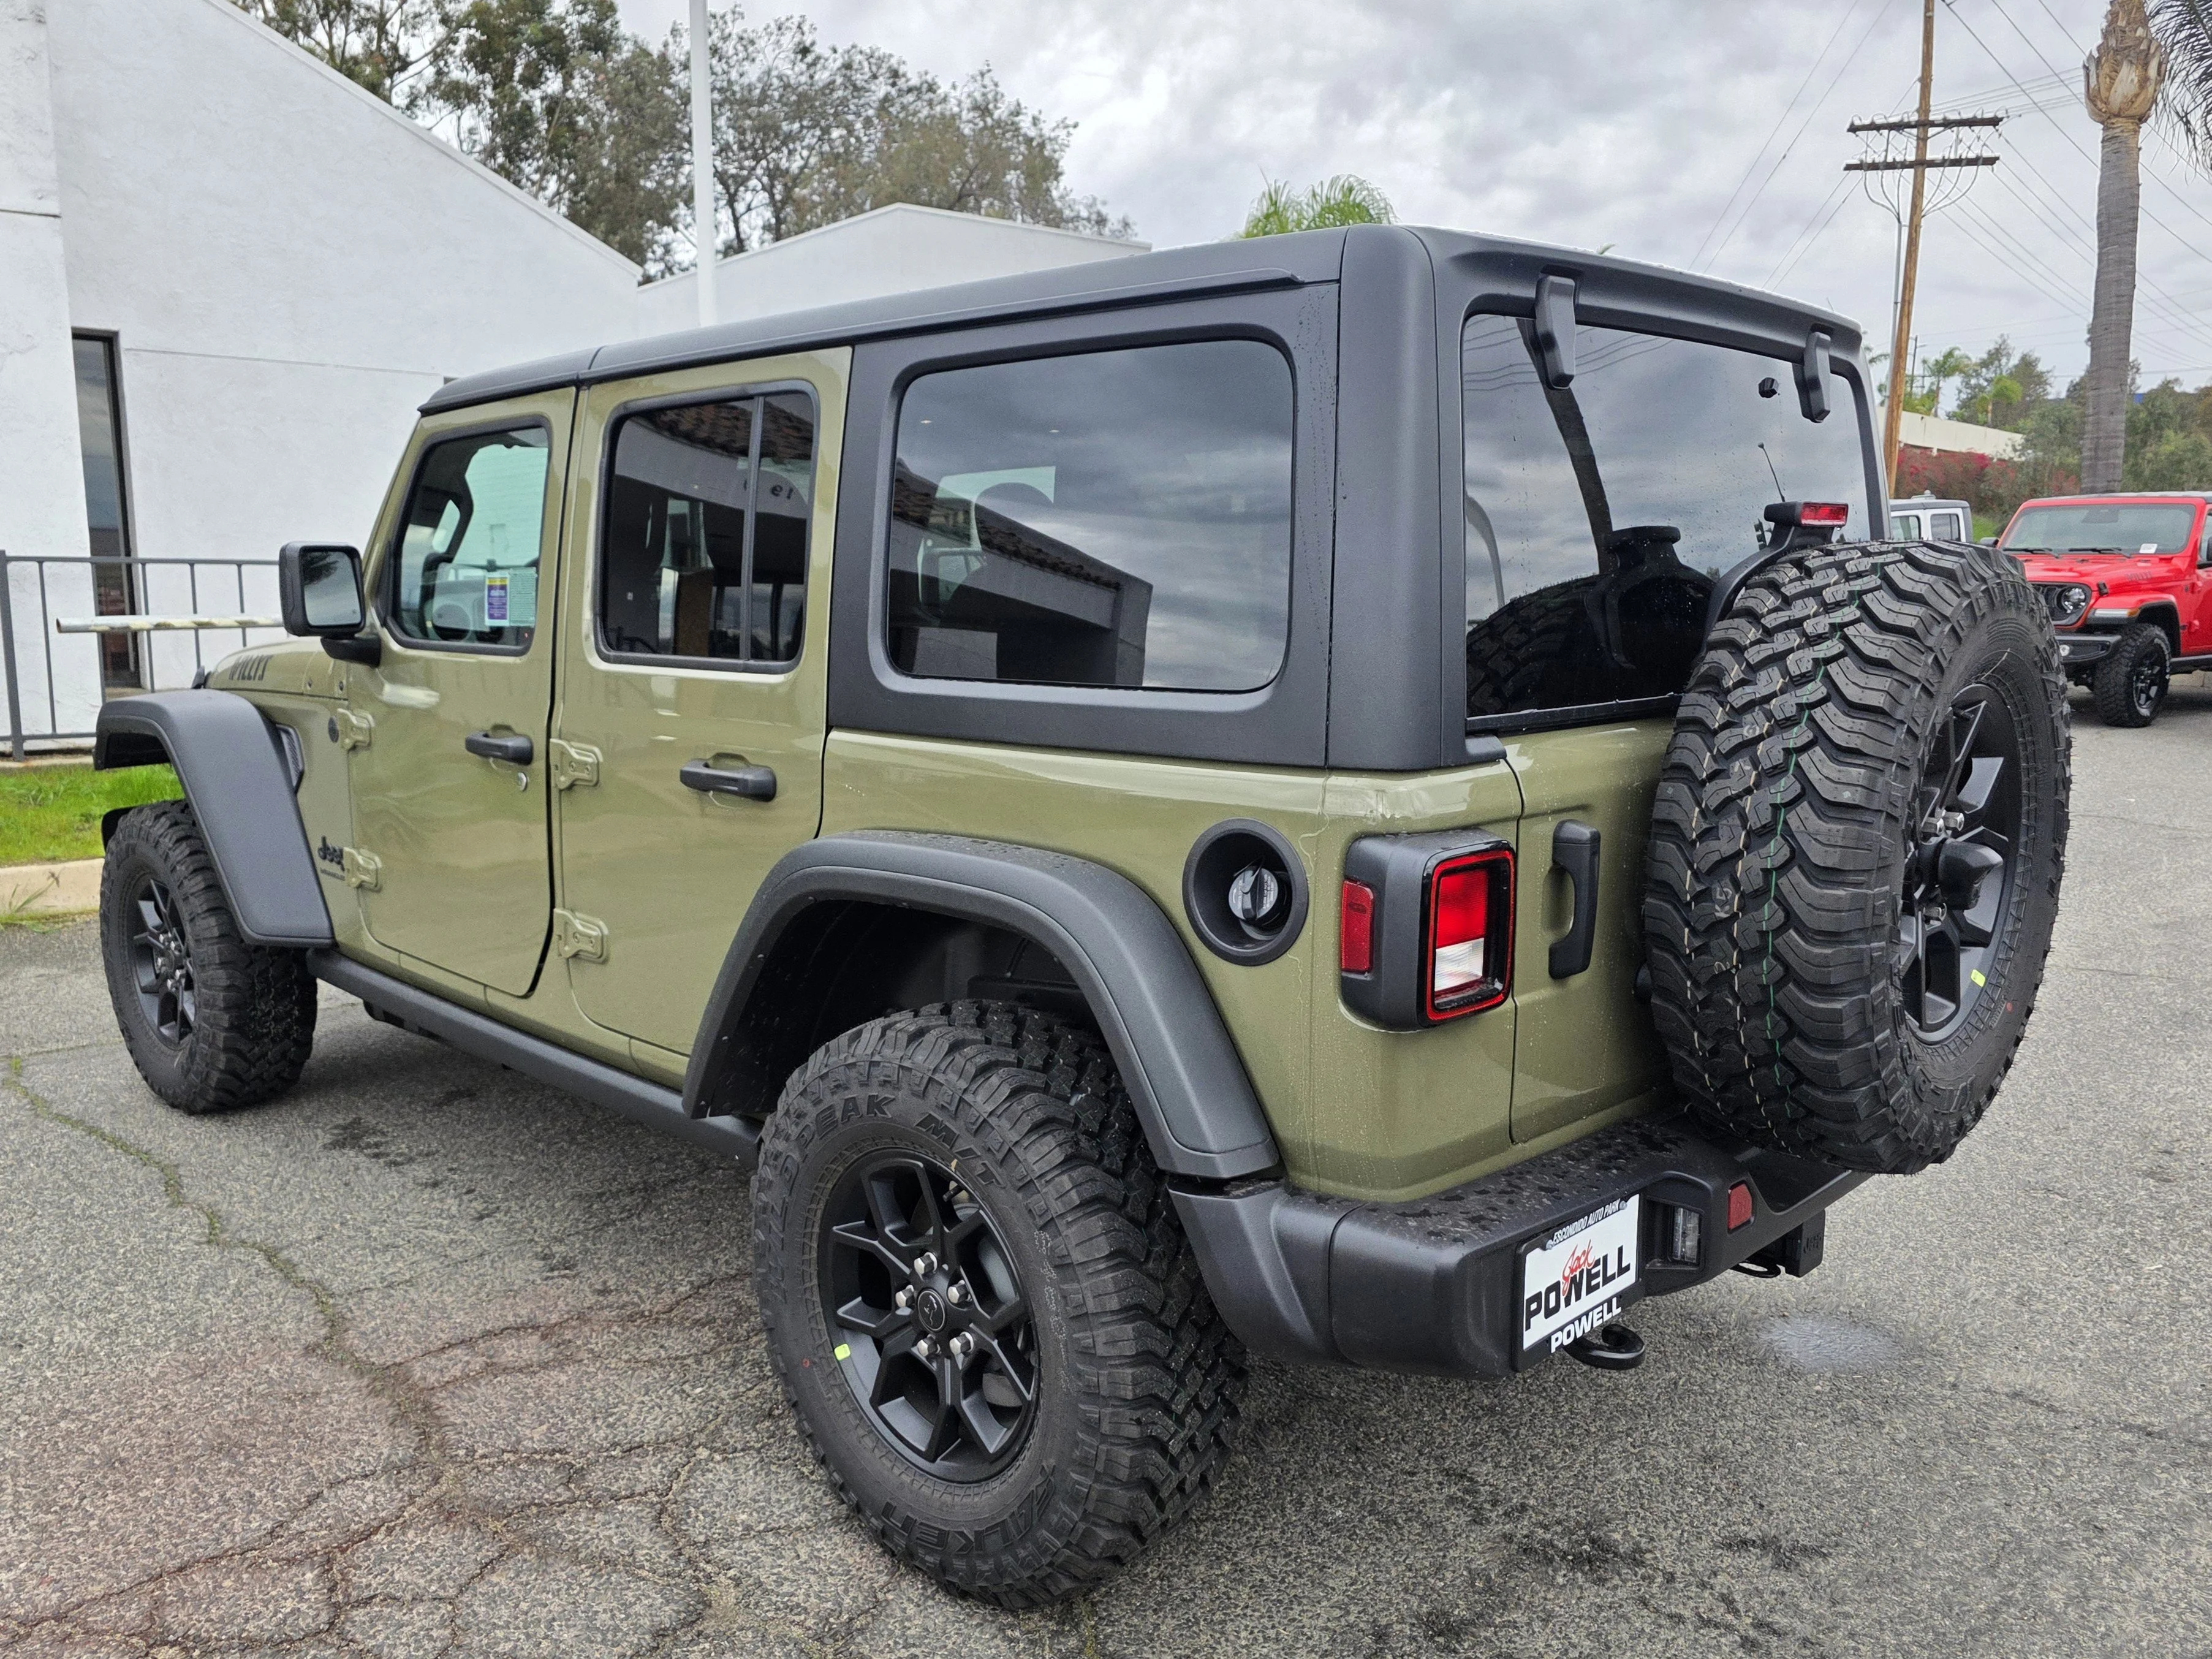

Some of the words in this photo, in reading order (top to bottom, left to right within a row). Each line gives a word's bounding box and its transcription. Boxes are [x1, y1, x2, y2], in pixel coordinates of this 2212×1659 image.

[229, 655, 273, 681] WILLYS
[1553, 1216, 1588, 1244] ESCONDIDO
[1587, 1207, 1604, 1227] AUTO
[1604, 1198, 1621, 1218] PARK
[1525, 1245, 1631, 1332] POWELL
[1562, 1239, 1595, 1297] Jack
[1551, 1297, 1621, 1353] POWELL
